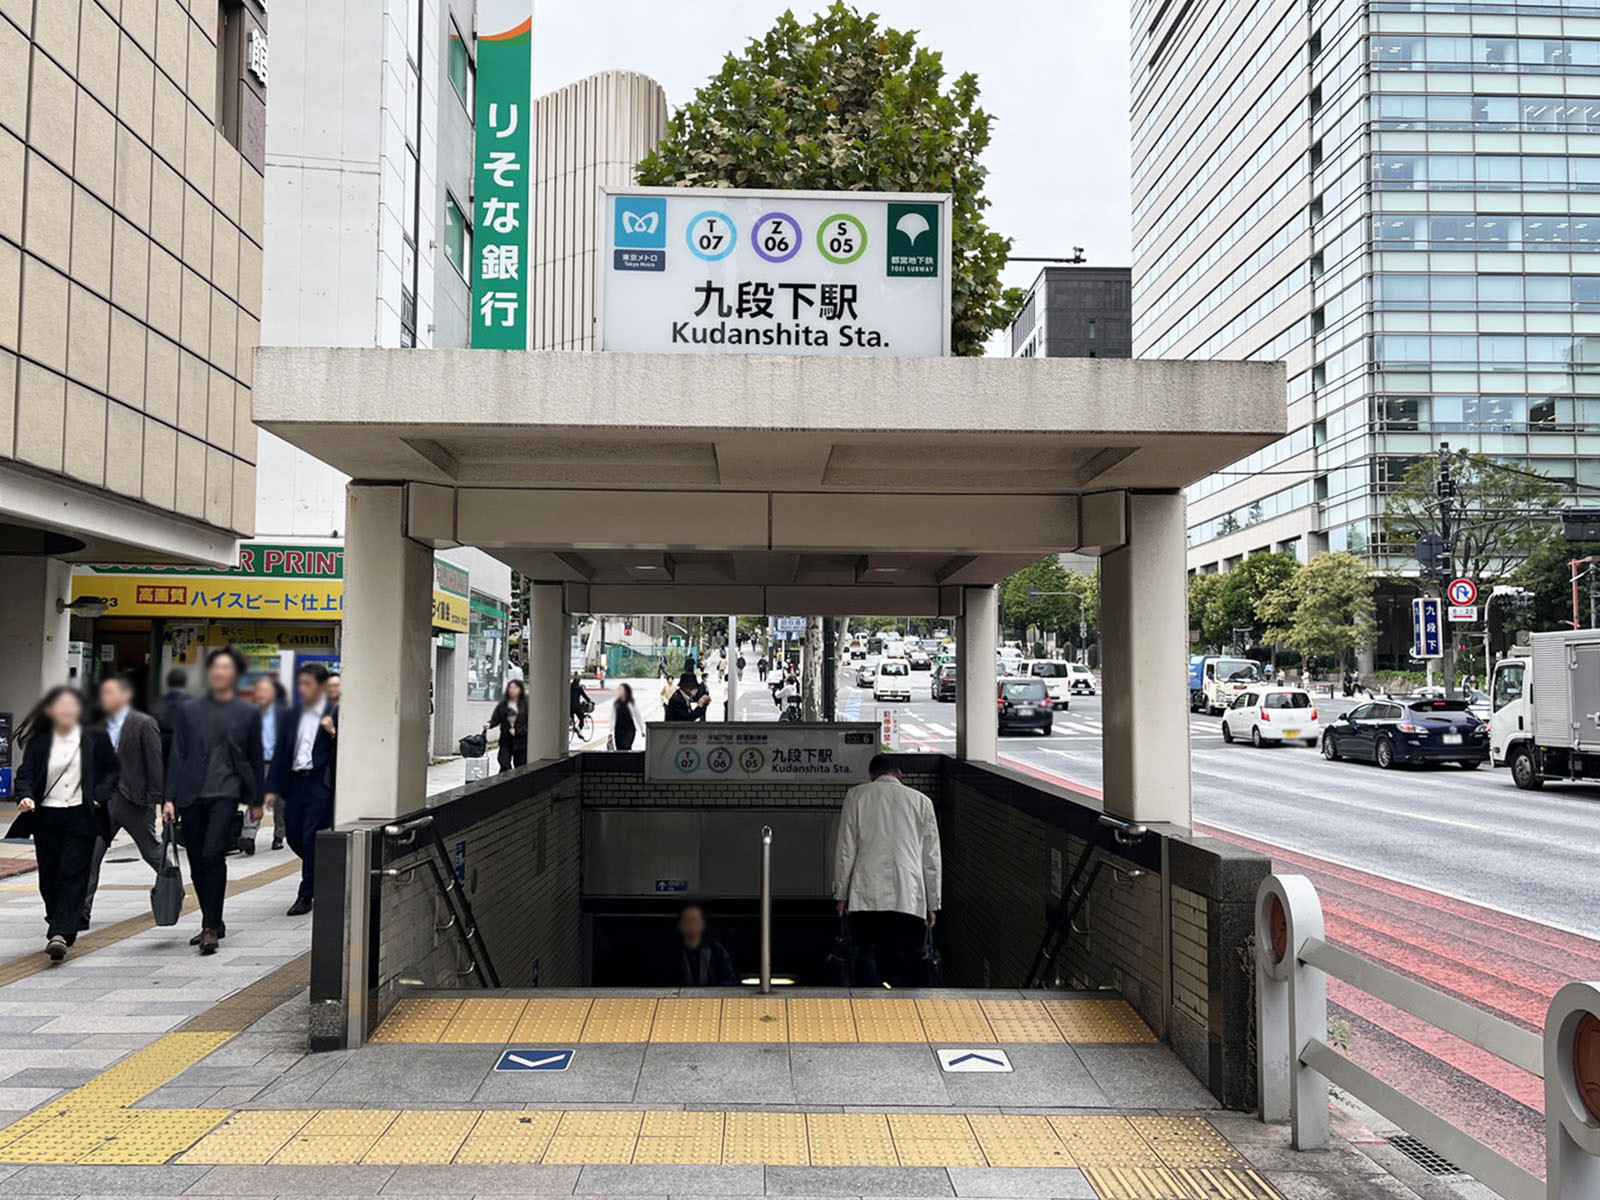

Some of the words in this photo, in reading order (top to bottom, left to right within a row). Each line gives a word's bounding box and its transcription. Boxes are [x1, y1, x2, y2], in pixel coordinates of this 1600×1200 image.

[481, 103, 520, 327] りそな銀行
[707, 220, 716, 233] T
[772, 221, 782, 234] Z
[838, 222, 847, 236] S
[699, 235, 723, 250] 07
[764, 236, 788, 252] 06
[829, 238, 854, 253] 05
[622, 254, 658, 262] 東京メトロ
[891, 256, 934, 265] 都営地下鉄
[694, 280, 858, 320] 九段下駅
[672, 322, 829, 347] Kudanshita
[839, 326, 889, 348] Sta.
[139, 587, 186, 603] 高画質
[1425, 606, 1437, 650] 九段下
[276, 632, 329, 645] Canon
[772, 749, 832, 763] 九段下駅
[681, 759, 694, 768] 07
[713, 759, 726, 768] 06
[745, 759, 758, 768] 05
[772, 764, 830, 773] Kudanshita
[833, 764, 852, 774] Sta.
